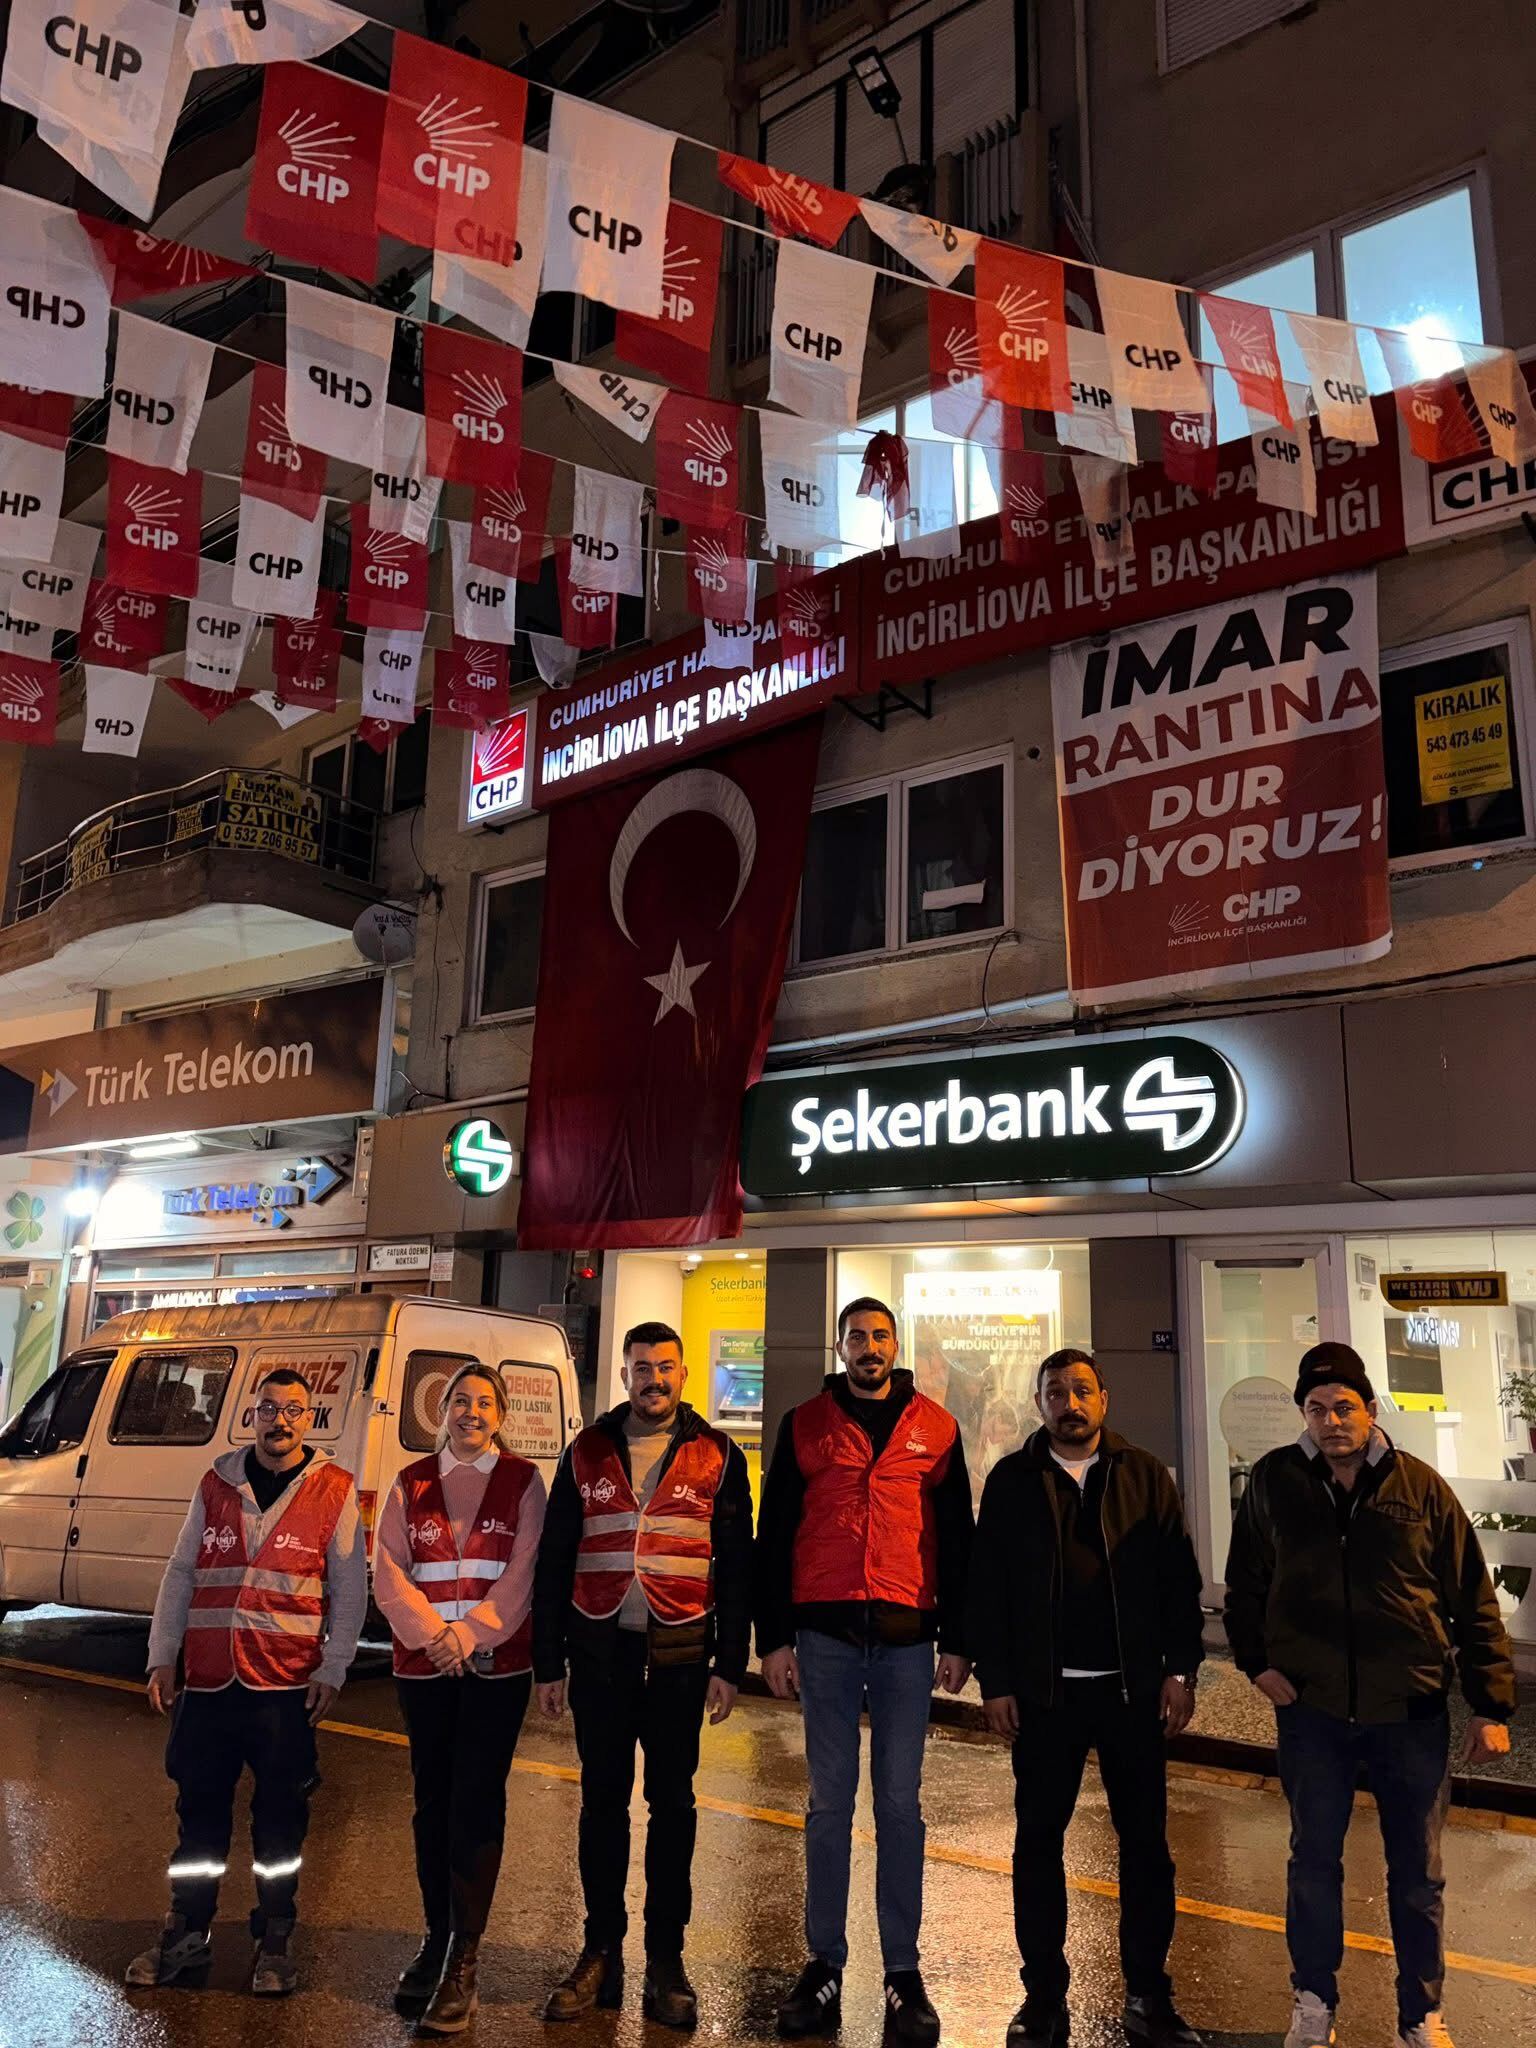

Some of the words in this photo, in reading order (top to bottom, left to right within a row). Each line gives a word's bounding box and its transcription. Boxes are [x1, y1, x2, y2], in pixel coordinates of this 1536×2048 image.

[44, 16, 142, 82] CHP
[277, 164, 349, 204] CHP
[413, 153, 490, 197] CHP
[568, 205, 642, 254] CHP
[661, 289, 694, 322] HP
[784, 323, 843, 361] CHP
[999, 332, 1049, 363] CHP
[1125, 343, 1181, 371] CHP
[1240, 354, 1277, 381] CHP
[1069, 381, 1112, 410] CHP
[1324, 377, 1368, 405] CHP
[1410, 399, 1443, 425] CHP
[1489, 402, 1518, 431] CHP
[1169, 420, 1211, 449] CHP
[1261, 437, 1300, 465] CHP
[1442, 457, 1536, 511] CH
[0, 491, 41, 518] HP
[125, 524, 178, 550] CHP
[249, 553, 303, 580] CHP
[877, 575, 1051, 660] İNCİRLİOVA
[1065, 560, 1138, 612] İLÇE
[1151, 478, 1381, 584] BAŞKANLIĞI
[884, 517, 1085, 595] CUMHUET
[22, 570, 73, 595] CHP
[364, 565, 409, 590] CHP
[116, 596, 156, 619] CHP
[465, 582, 505, 608] CHP
[571, 593, 611, 613] CHP
[196, 616, 241, 640] CHP
[286, 635, 316, 652] CH
[379, 648, 412, 671] CHP
[466, 671, 497, 691] CHP
[542, 716, 649, 785] İNCİRLİOVA
[654, 701, 700, 745] İLÇE
[706, 636, 845, 722] BAŞKANLIĞI
[550, 661, 677, 731] CUMHURİYET
[1423, 684, 1501, 720] KİRALIK
[1063, 667, 1378, 787] RANTINA
[1427, 735, 1447, 753] 543
[1449, 730, 1469, 748] 473
[1472, 726, 1486, 743] 45
[1488, 722, 1502, 739] 49
[237, 777, 294, 801] FURKAN
[475, 776, 519, 811] CHP
[1149, 765, 1284, 831] DUR
[227, 803, 315, 842] SATILIK
[224, 826, 231, 839] 0
[235, 827, 258, 842] 532
[262, 831, 283, 848] 206
[285, 839, 297, 854] 95
[300, 843, 315, 858] 57
[1222, 884, 1301, 923] CHP
[1168, 928, 1221, 948] İNCİRLİOVA
[1223, 925, 1246, 940] İLÇE
[86, 1058, 153, 1108] Türk
[164, 1040, 313, 1096] Telekom
[791, 1067, 1112, 1175] Şekerbank
[1391, 1281, 1449, 1290] WESTERN
[1410, 1290, 1449, 1298] UNION
[525, 1398, 552, 1413] LASTİK
